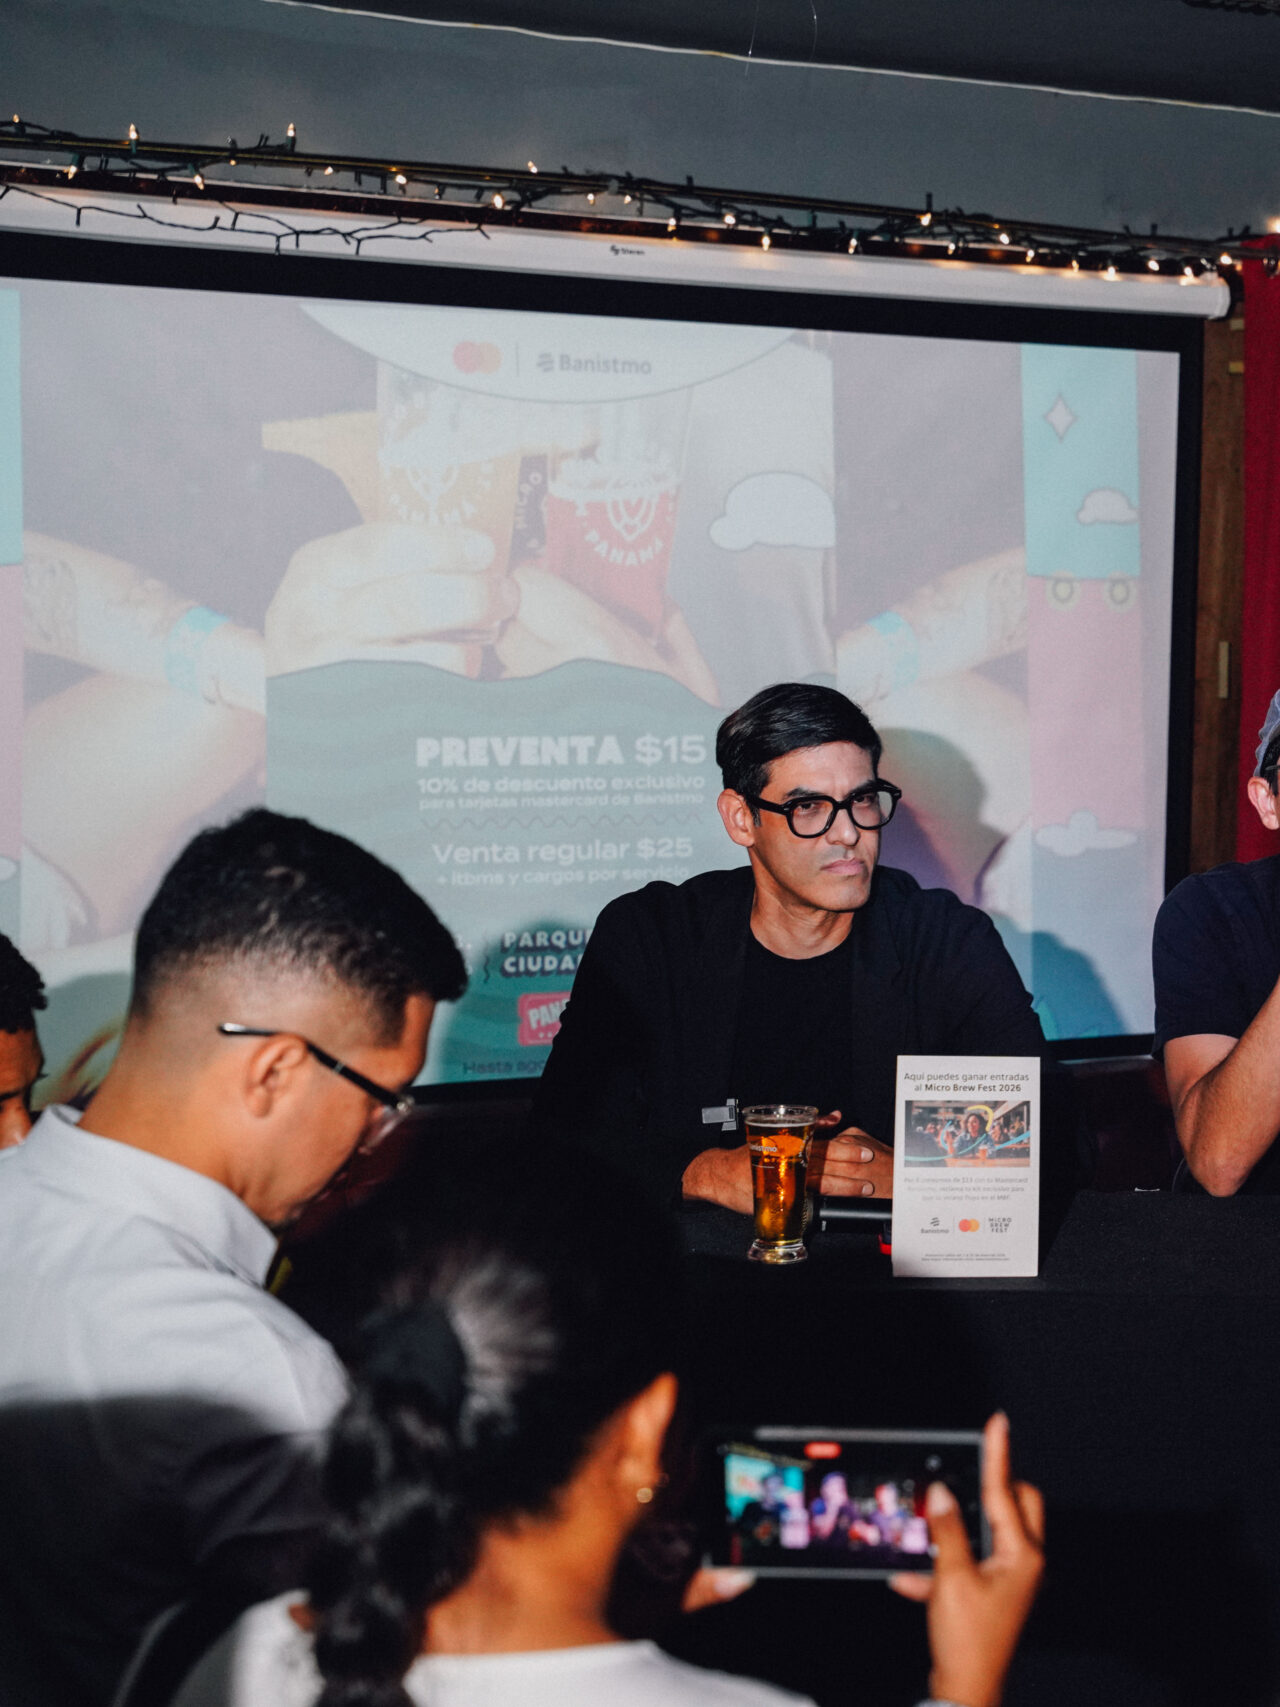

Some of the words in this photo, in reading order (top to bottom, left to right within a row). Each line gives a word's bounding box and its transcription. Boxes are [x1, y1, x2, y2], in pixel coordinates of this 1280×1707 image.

[560, 353, 651, 375] Banistmo
[584, 528, 664, 566] PANAMA
[416, 735, 625, 768] PREVENTA
[635, 733, 707, 766] $15
[417, 778, 459, 794] 10%
[463, 777, 490, 793] de
[495, 776, 607, 793] descuento
[611, 774, 706, 790] exclusivo
[419, 799, 455, 810] para
[612, 793, 630, 805] de
[432, 842, 521, 864] Venta
[528, 839, 630, 866] regular
[636, 836, 693, 862] $25
[508, 871, 519, 885] y
[522, 868, 585, 884] cargos
[588, 867, 616, 883] por
[622, 864, 689, 881] servicio
[503, 954, 582, 974] CIUDA
[463, 1061, 513, 1075] Hasta
[904, 1072, 925, 1082] Aquí
[927, 1072, 960, 1082] puedes
[962, 1074, 988, 1082] ganar
[990, 1073, 1030, 1081] entradas
[914, 1083, 922, 1092] al
[925, 1083, 951, 1092] Micro
[953, 1083, 975, 1092] Brew
[978, 1084, 997, 1092] Fest
[999, 1084, 1022, 1092] 2026
